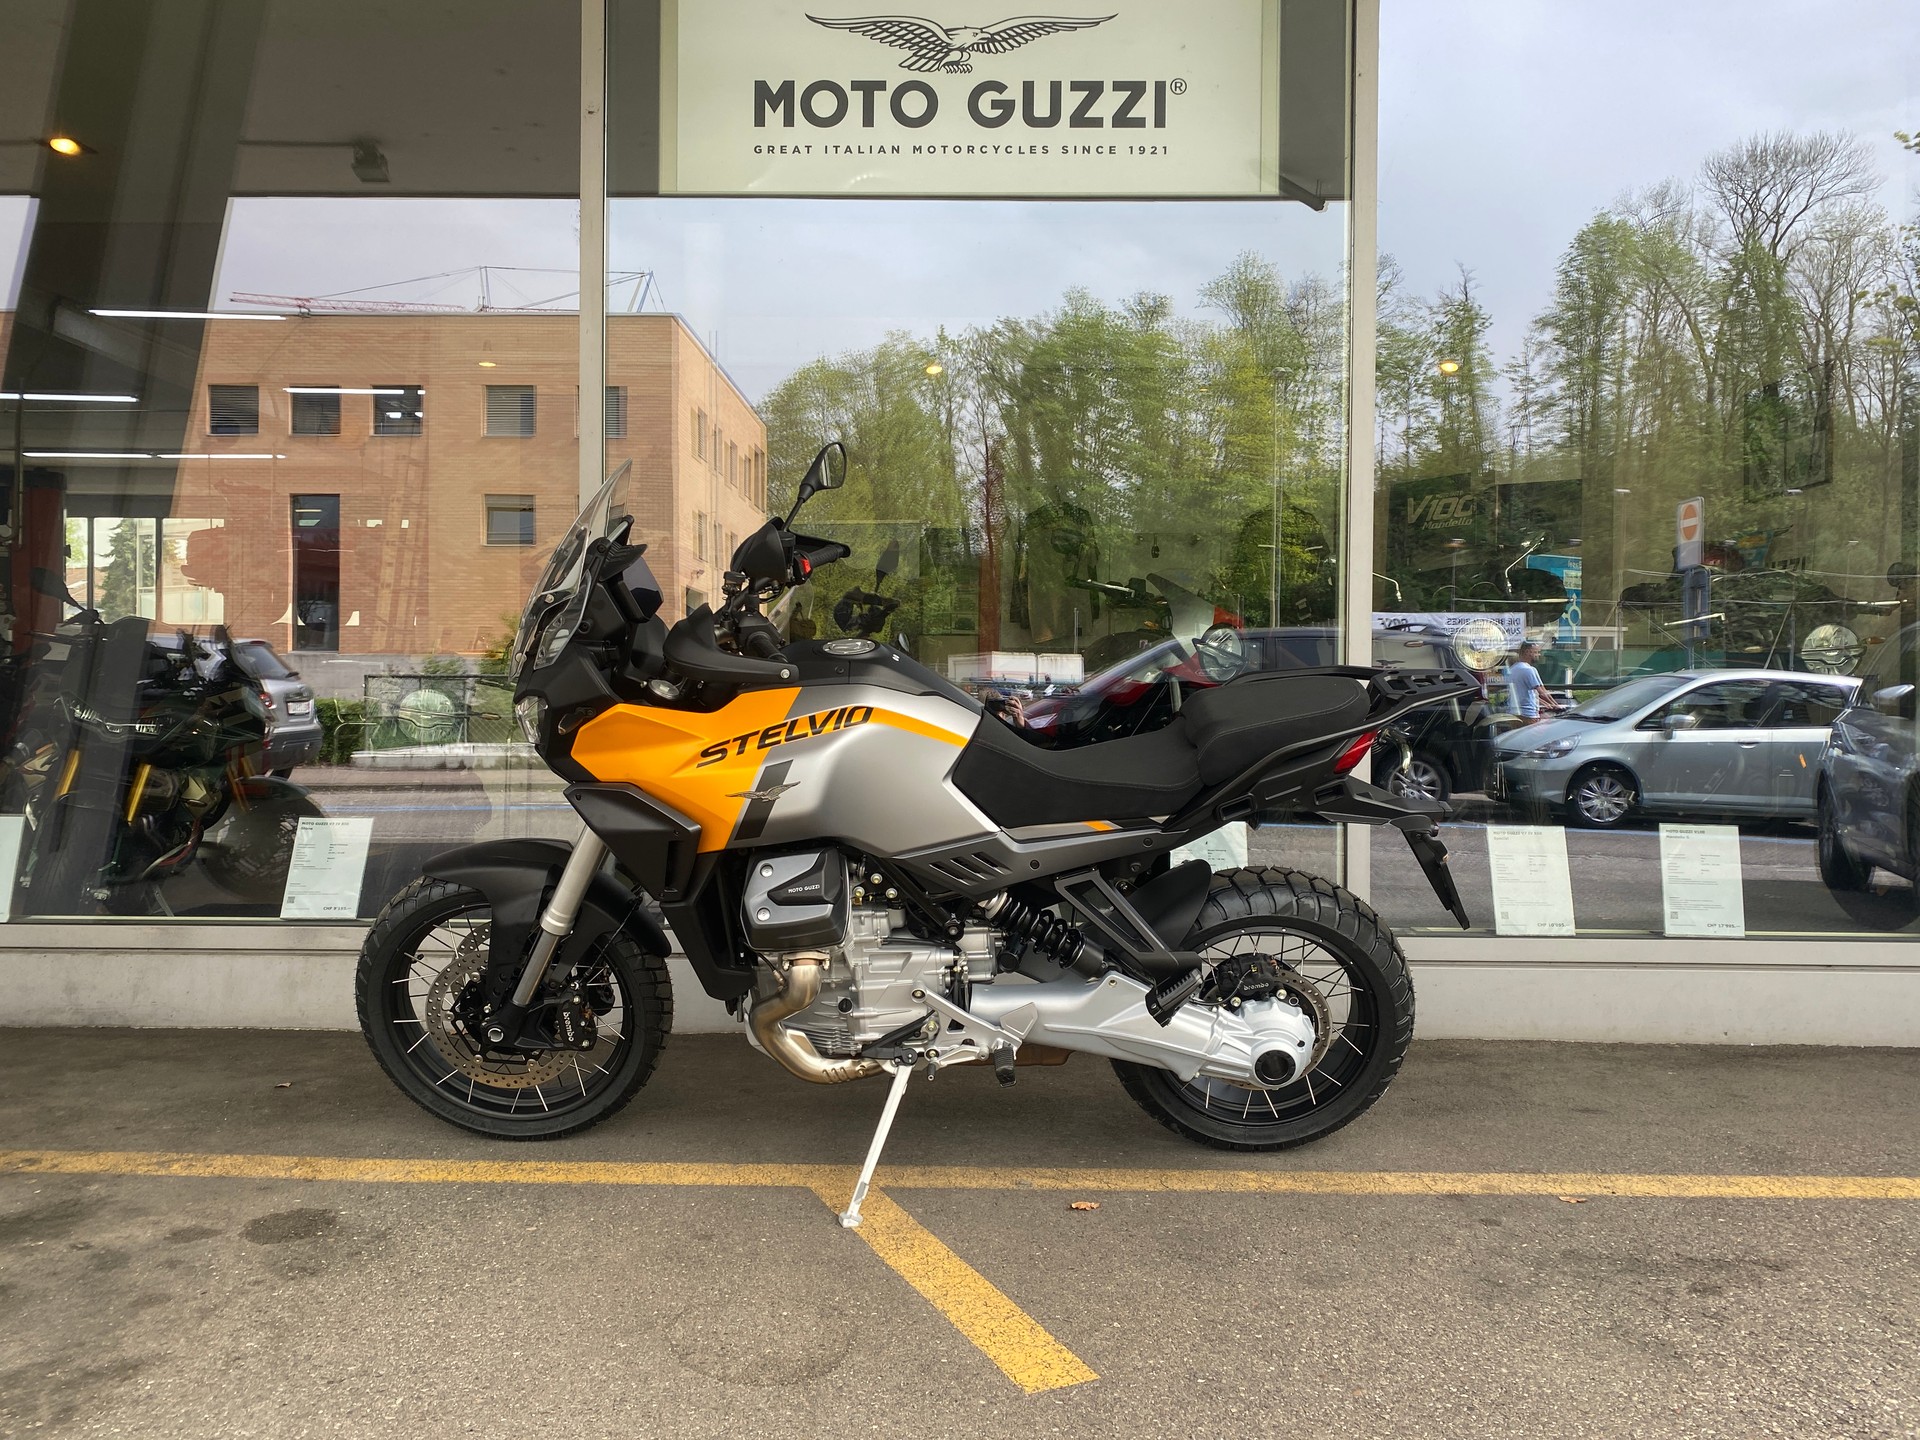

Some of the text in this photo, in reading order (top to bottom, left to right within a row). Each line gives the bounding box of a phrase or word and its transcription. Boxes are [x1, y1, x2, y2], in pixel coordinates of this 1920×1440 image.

[753, 79, 939, 129] MOTO
[753, 144, 1167, 155] GREAT ITALIAN MOTORCYCLES SINCE 1921
[1422, 517, 1473, 530] Mandello
[696, 706, 875, 769] STELVIO
[788, 886, 803, 894] MOTO
[1243, 982, 1269, 991] brembo
[562, 1011, 575, 1042] brembo
